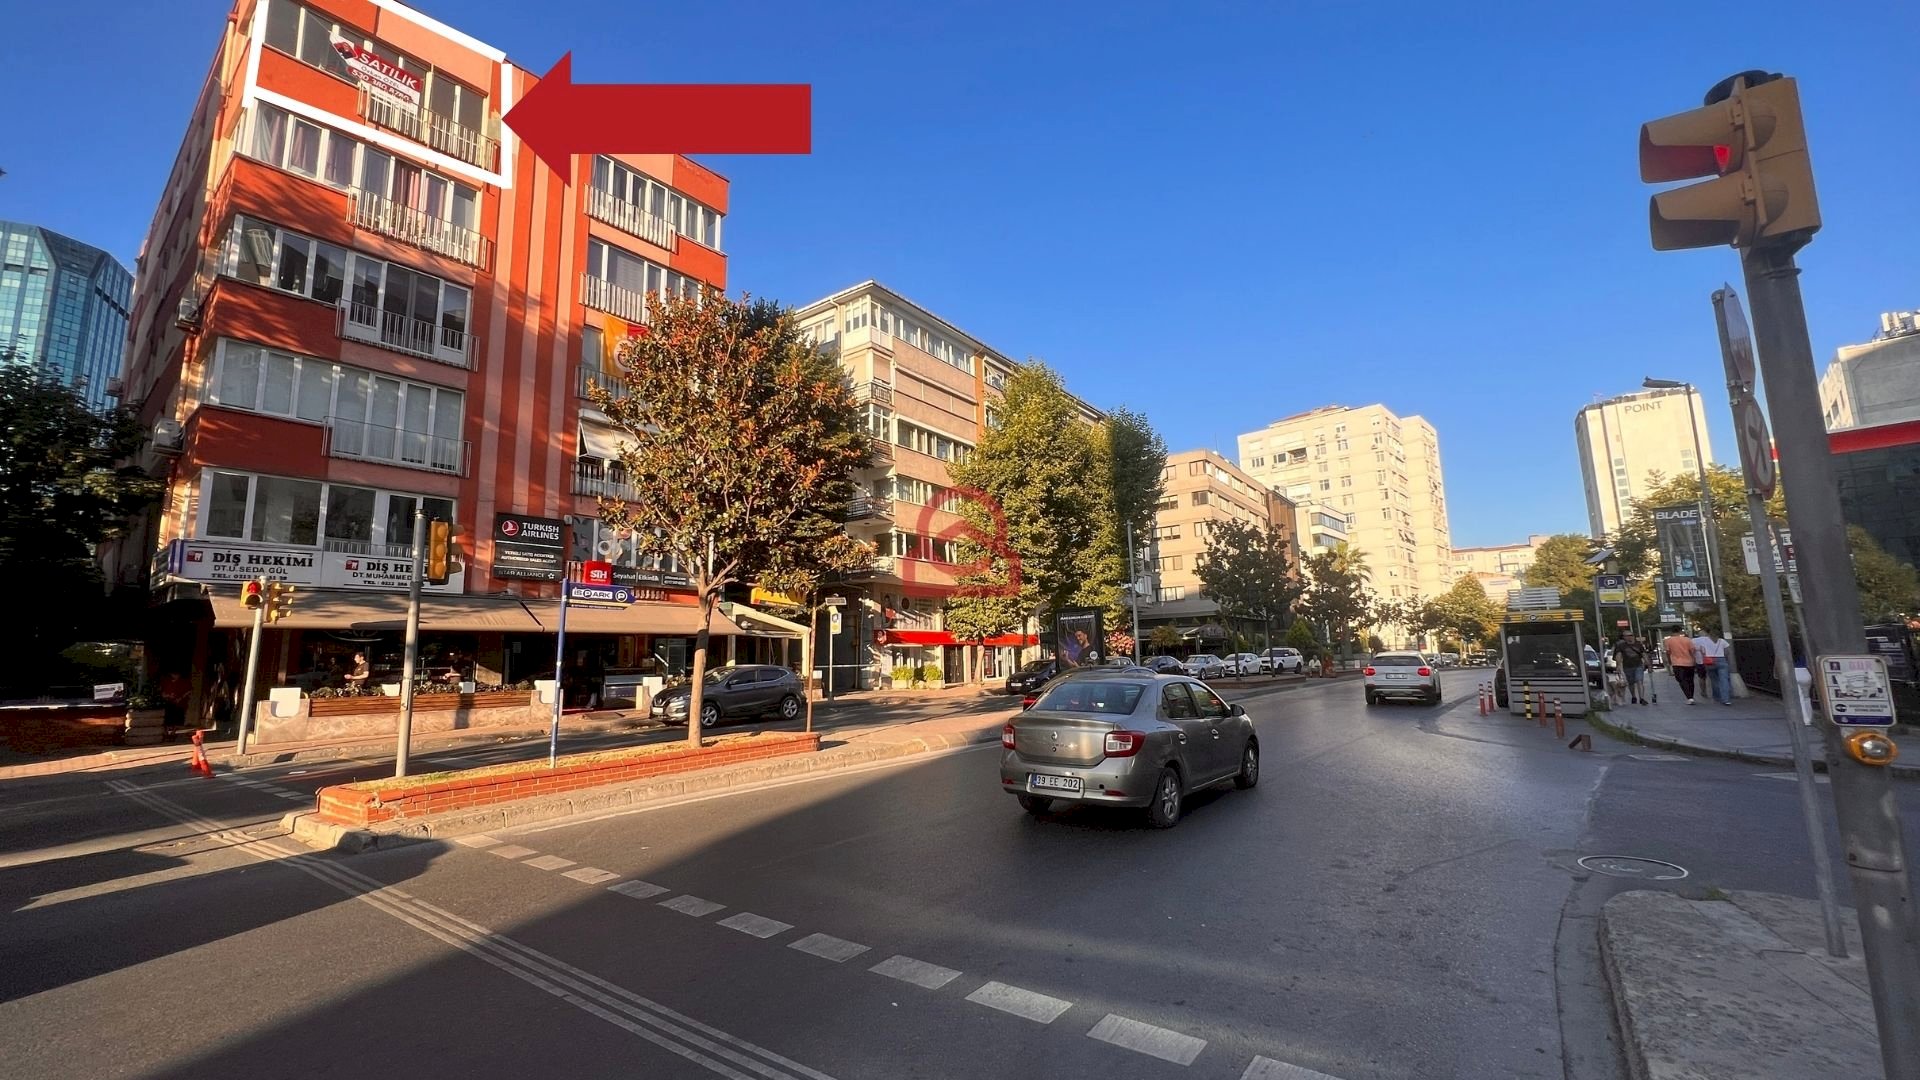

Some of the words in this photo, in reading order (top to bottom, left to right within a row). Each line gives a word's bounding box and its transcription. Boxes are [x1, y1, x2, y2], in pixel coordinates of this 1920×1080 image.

[360, 53, 418, 89] SATILIK
[1624, 400, 1662, 414] POINT
[1656, 509, 1698, 520] BLADE
[522, 522, 560, 533] TURKISH
[521, 529, 560, 540] AIRLINES
[213, 551, 241, 566] DİŞ
[247, 554, 314, 567] HEKİMİ
[268, 567, 288, 575] GÜL
[366, 560, 388, 573] DİŞ
[613, 572, 636, 580] Seyahat
[1669, 590, 1682, 598] TER
[1062, 778, 1078, 789] 202
